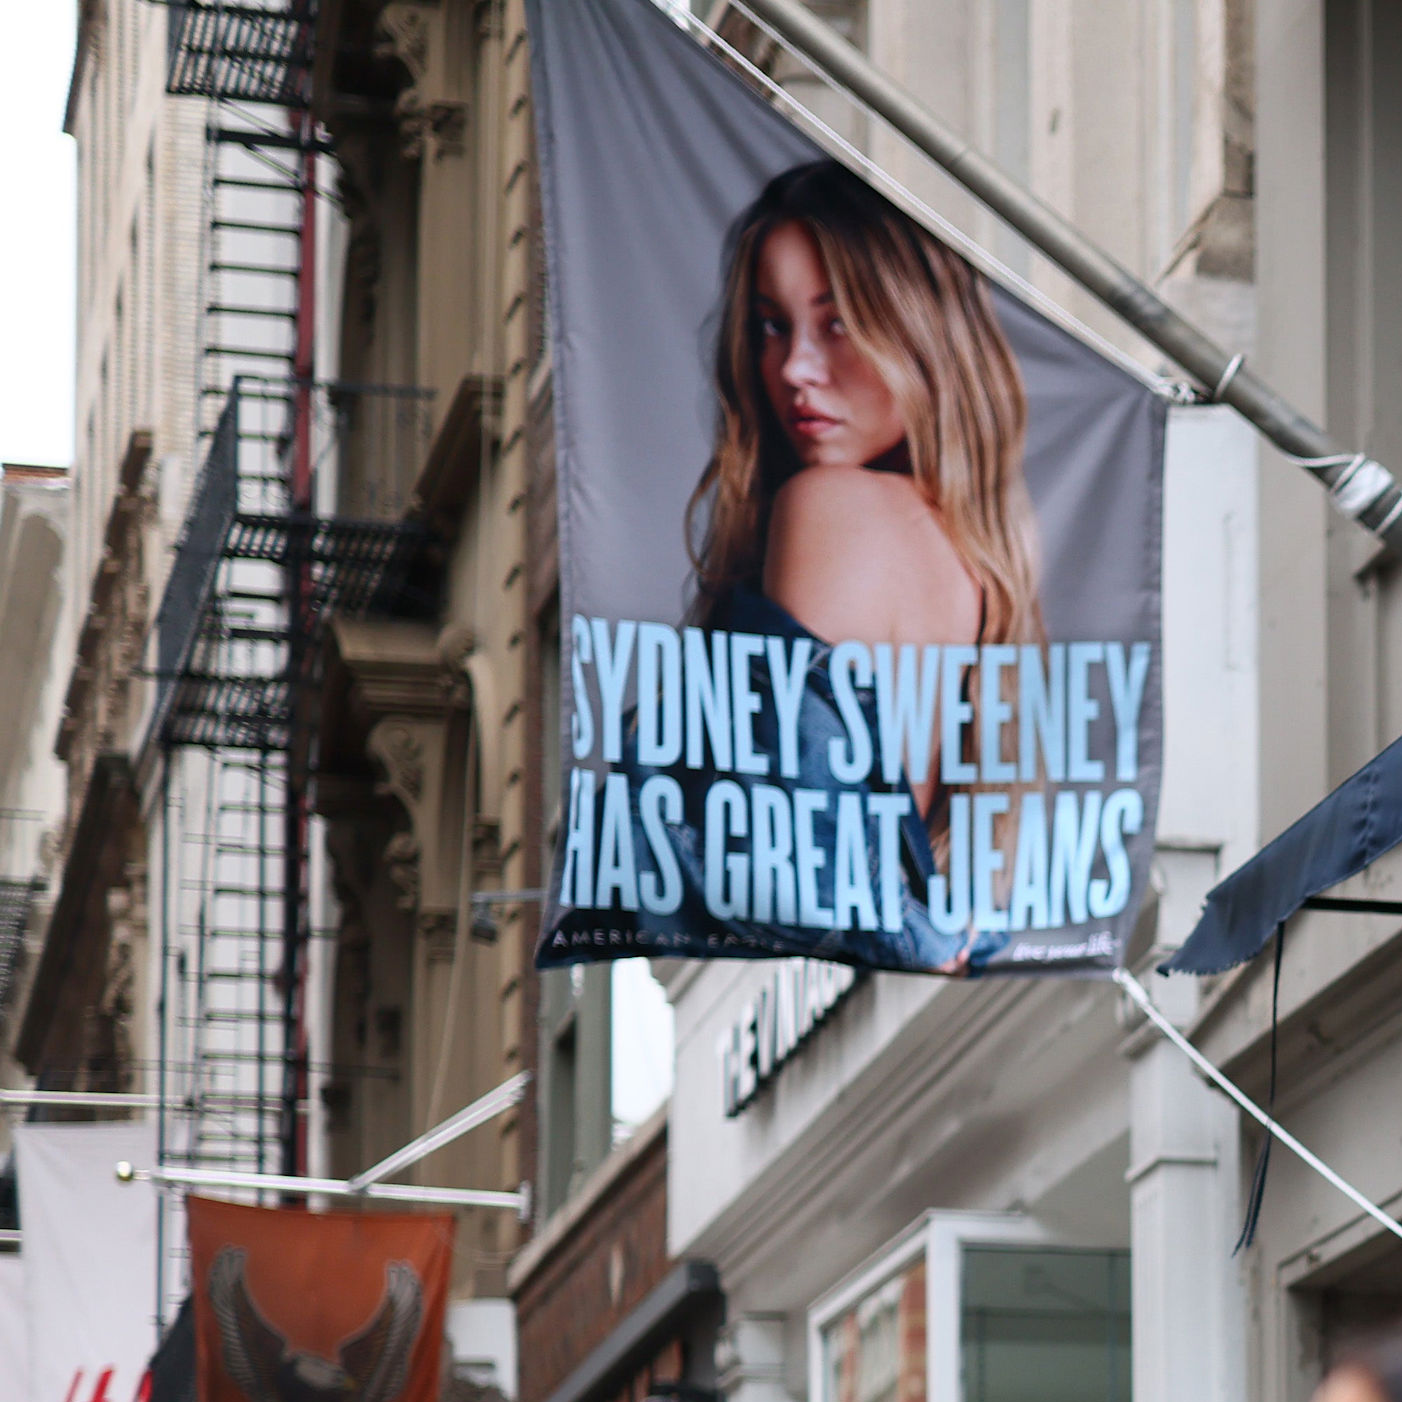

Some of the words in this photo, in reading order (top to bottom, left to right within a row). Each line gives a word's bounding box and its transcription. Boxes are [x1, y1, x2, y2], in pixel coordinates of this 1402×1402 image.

[570, 613, 814, 780] SYDNEY
[827, 640, 1152, 785] SWEENEY
[559, 766, 684, 917] HAS
[704, 780, 911, 935] GREAT
[927, 788, 1144, 936] JEANS
[552, 928, 693, 949] AMERICAN
